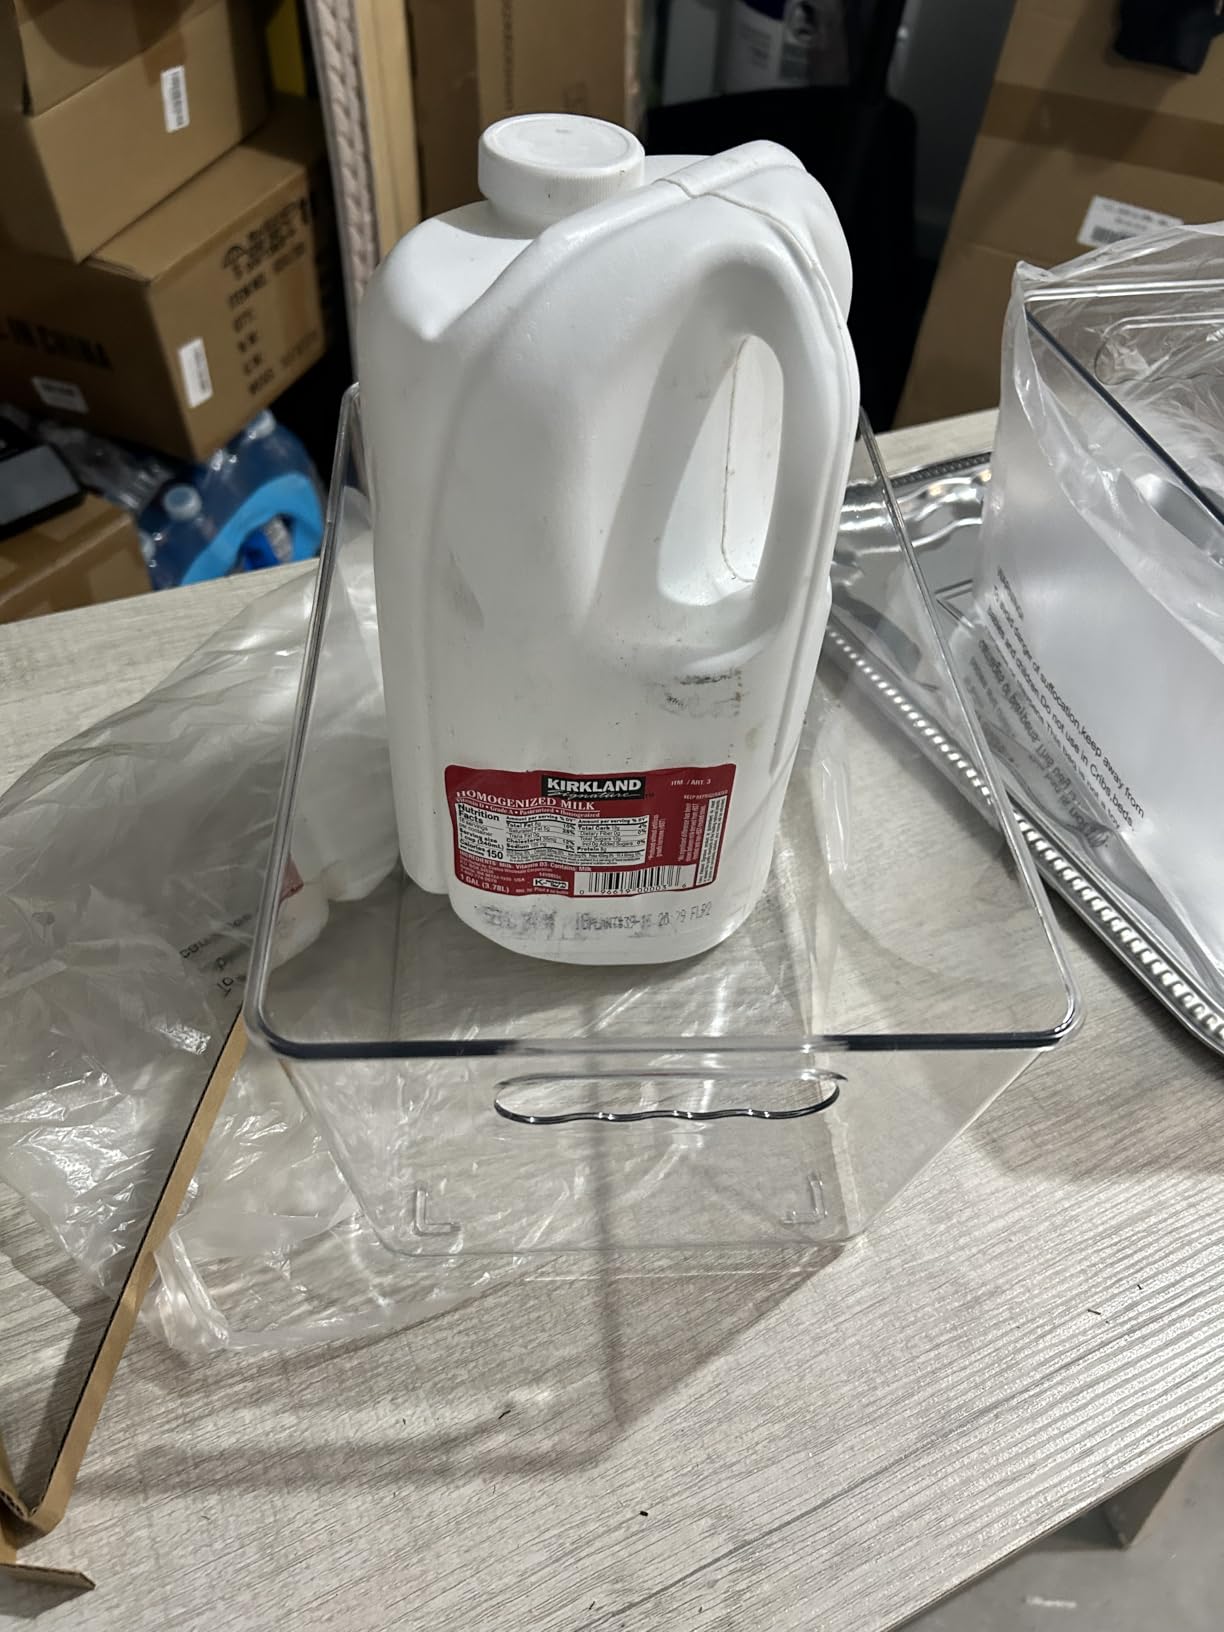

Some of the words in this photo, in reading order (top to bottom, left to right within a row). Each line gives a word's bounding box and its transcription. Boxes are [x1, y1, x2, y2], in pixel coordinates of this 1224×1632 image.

[1051, 713, 1064, 733] not
[1065, 731, 1080, 754] use
[1080, 751, 1089, 768] in
[547, 777, 643, 793] KIRKLAND
[1102, 756, 1124, 790] away
[1124, 787, 1144, 819] from
[456, 789, 557, 808] HOMOGENIZED
[560, 800, 595, 810] MILK
[548, 789, 630, 801] Signature
[459, 803, 500, 822] Nutrition
[459, 809, 484, 825] Facts
[506, 820, 522, 828] Total
[460, 839, 486, 852] Calories
[486, 848, 504, 860] 150
[515, 862, 540, 870] Vitamin
[465, 875, 481, 887] GAL
